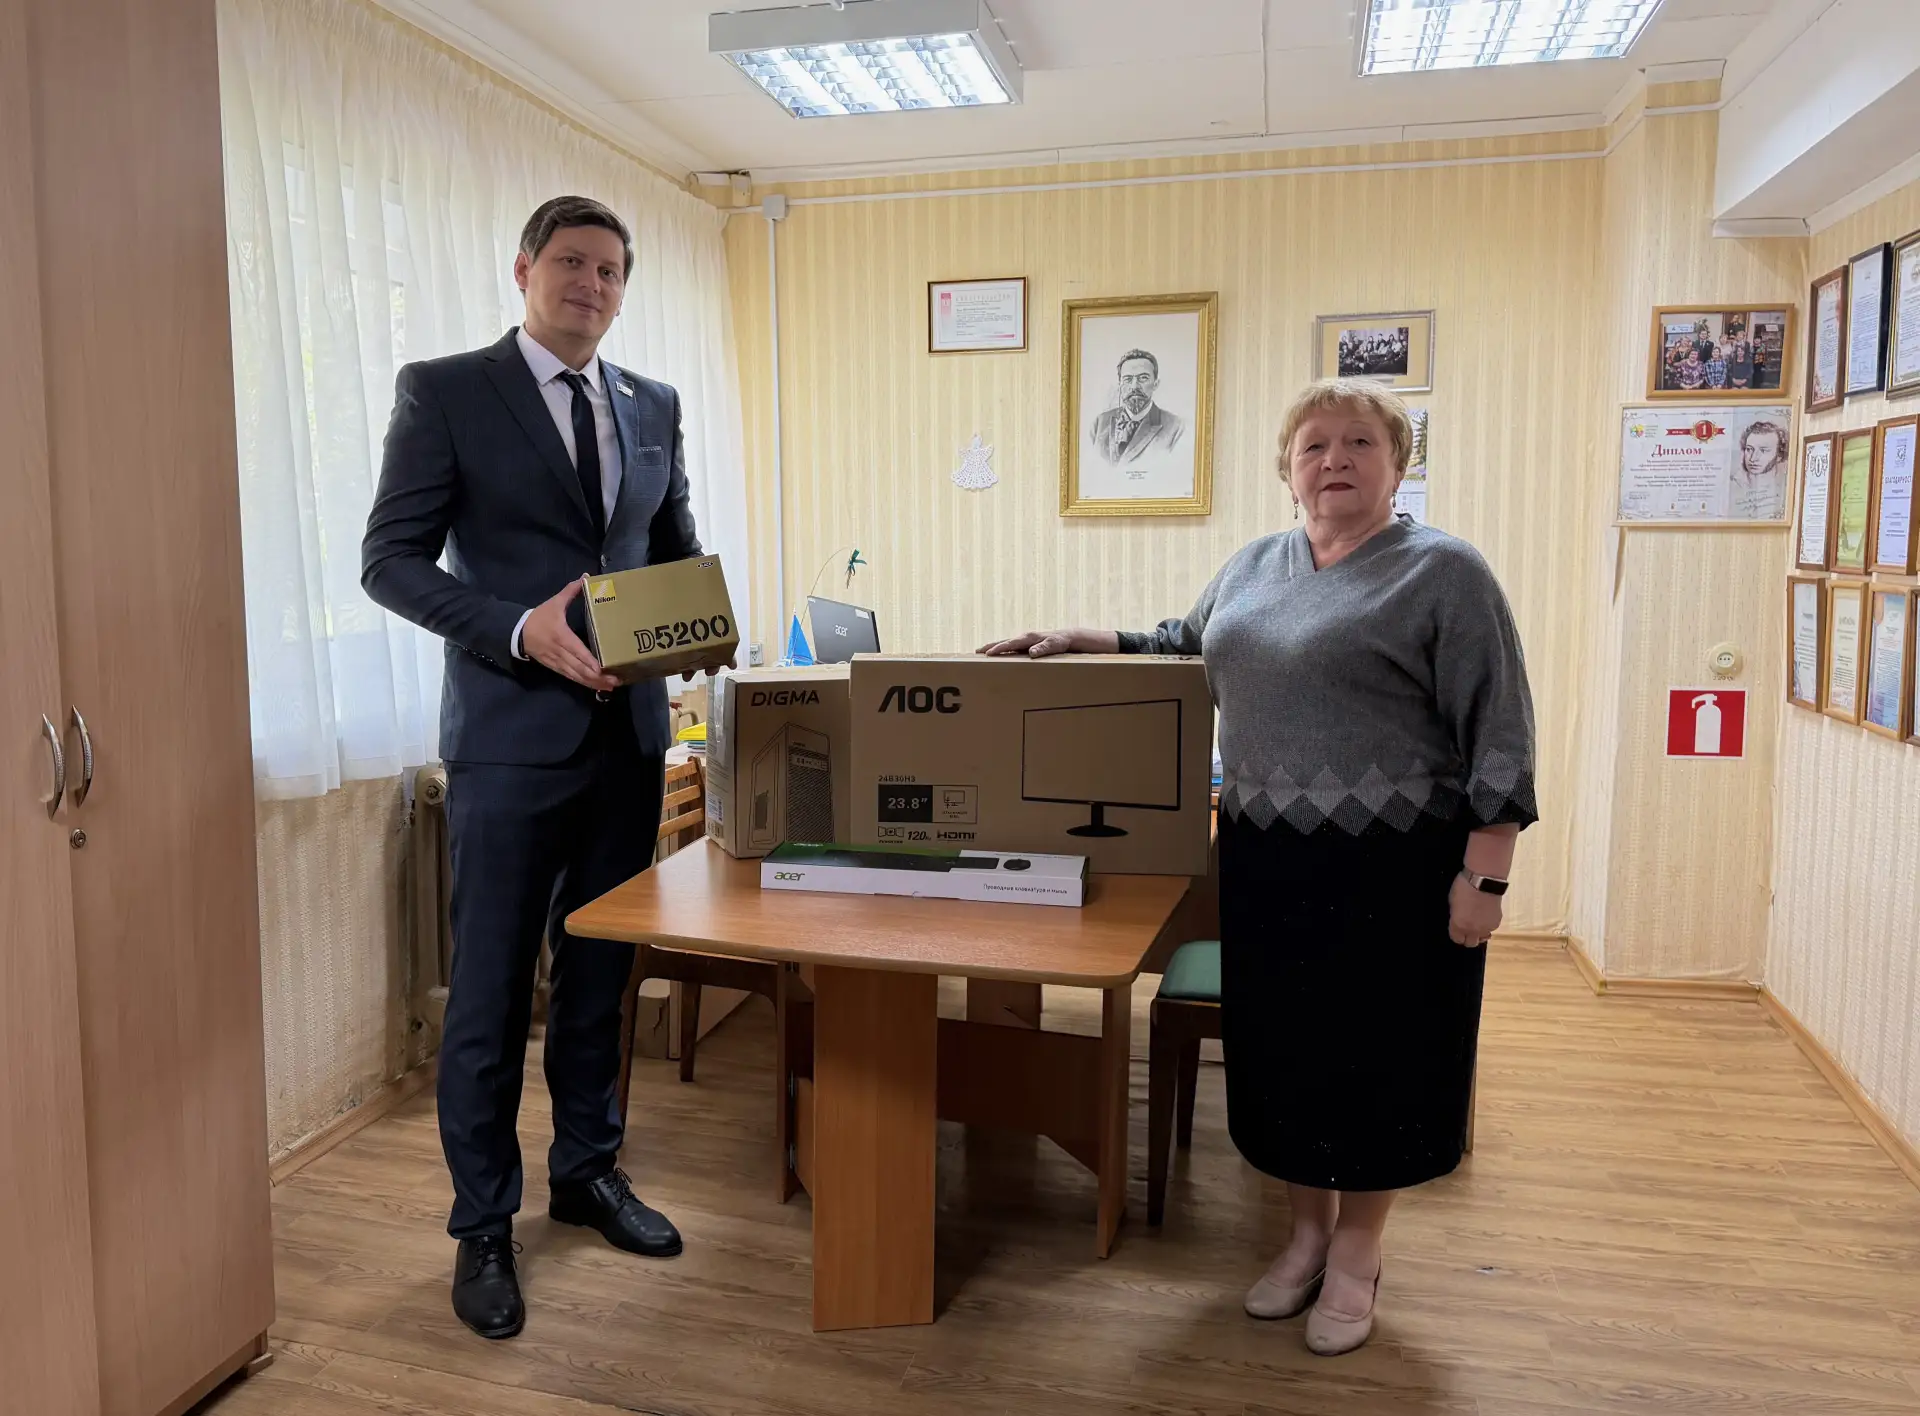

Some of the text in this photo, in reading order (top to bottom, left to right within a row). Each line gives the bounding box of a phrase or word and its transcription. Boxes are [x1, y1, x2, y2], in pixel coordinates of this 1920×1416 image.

[1651, 444, 1702, 458] Диплом
[594, 595, 616, 605] Nikon
[634, 614, 730, 655] D5200
[835, 625, 848, 637] acer
[751, 689, 820, 707] DIGMA
[877, 685, 963, 714] AOC
[937, 829, 975, 840] HDMI
[774, 871, 806, 882] acer
[983, 883, 1014, 892] Проводные
[1015, 885, 1046, 894] клавиатура
